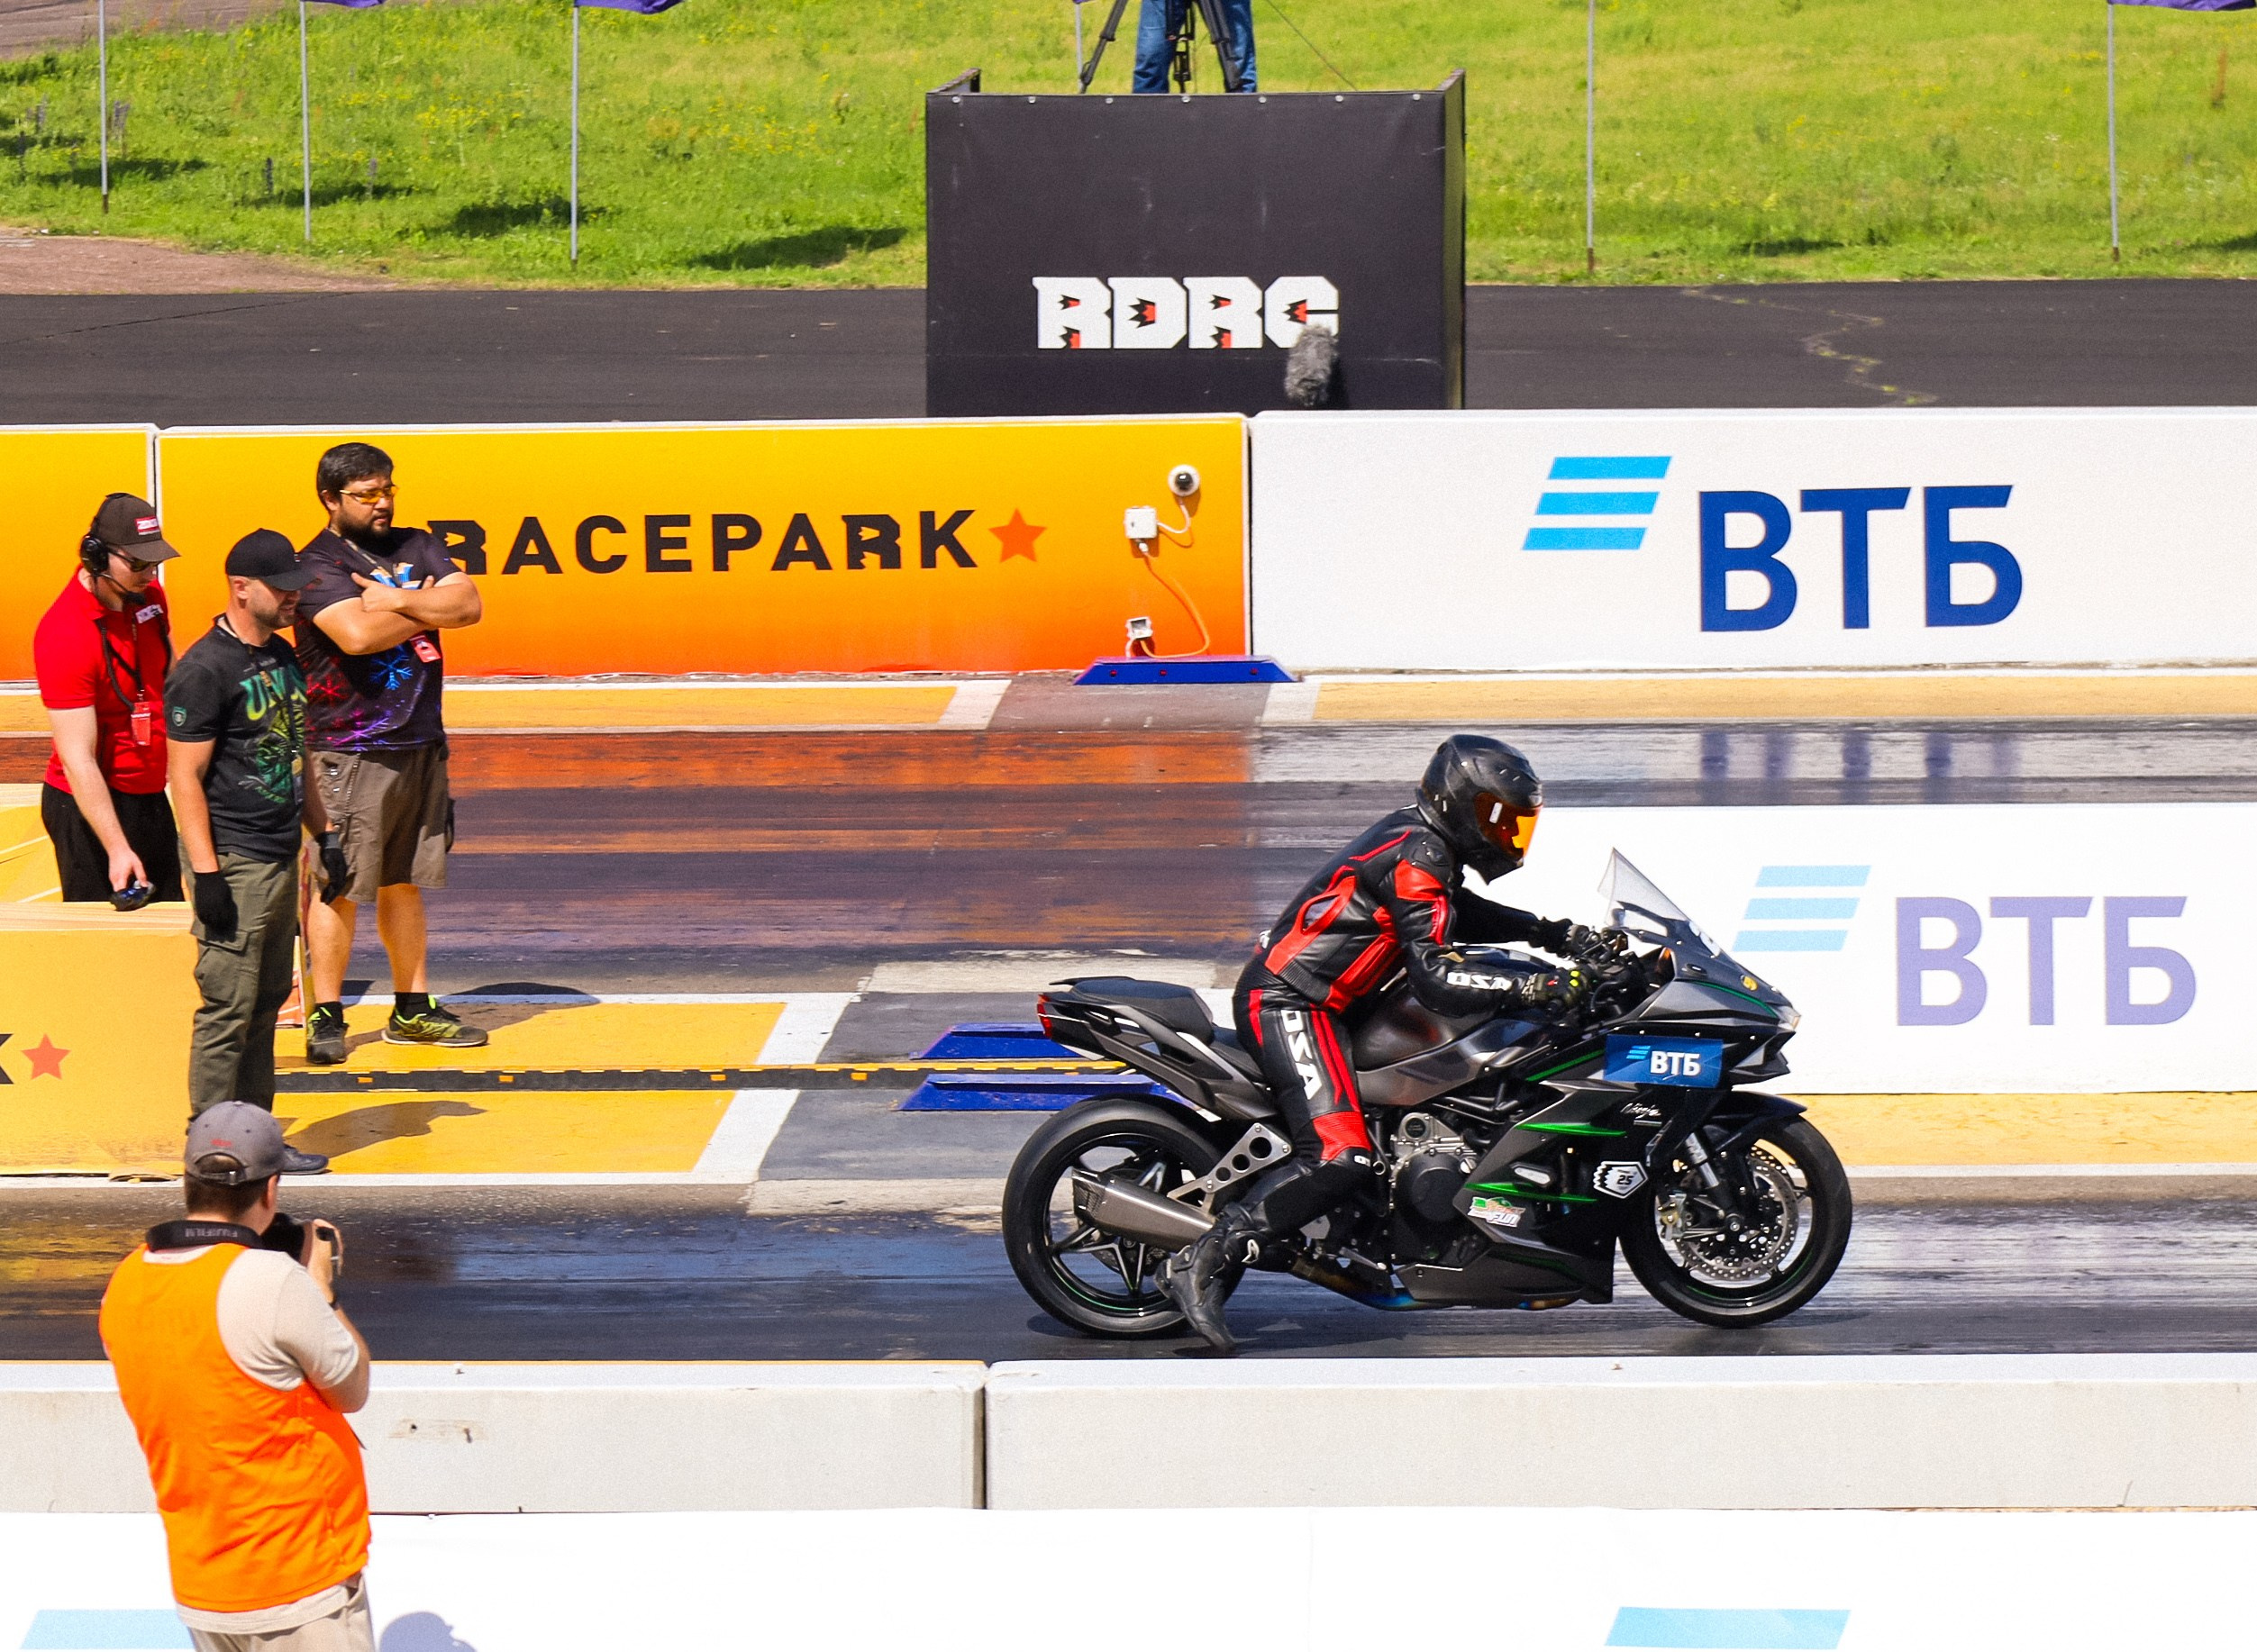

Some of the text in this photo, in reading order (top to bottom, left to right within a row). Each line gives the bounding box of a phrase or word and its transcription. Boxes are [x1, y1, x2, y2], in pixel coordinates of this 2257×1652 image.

[1032, 276, 1339, 349] RDRC
[427, 509, 978, 575] RACEPARK
[1698, 485, 2023, 632] ВТБ
[1896, 895, 2197, 1026] ВТБ
[1650, 1050, 1701, 1076] ВТБ
[1620, 1103, 1662, 1120] Ninja
[1616, 1174, 1634, 1186] 25
